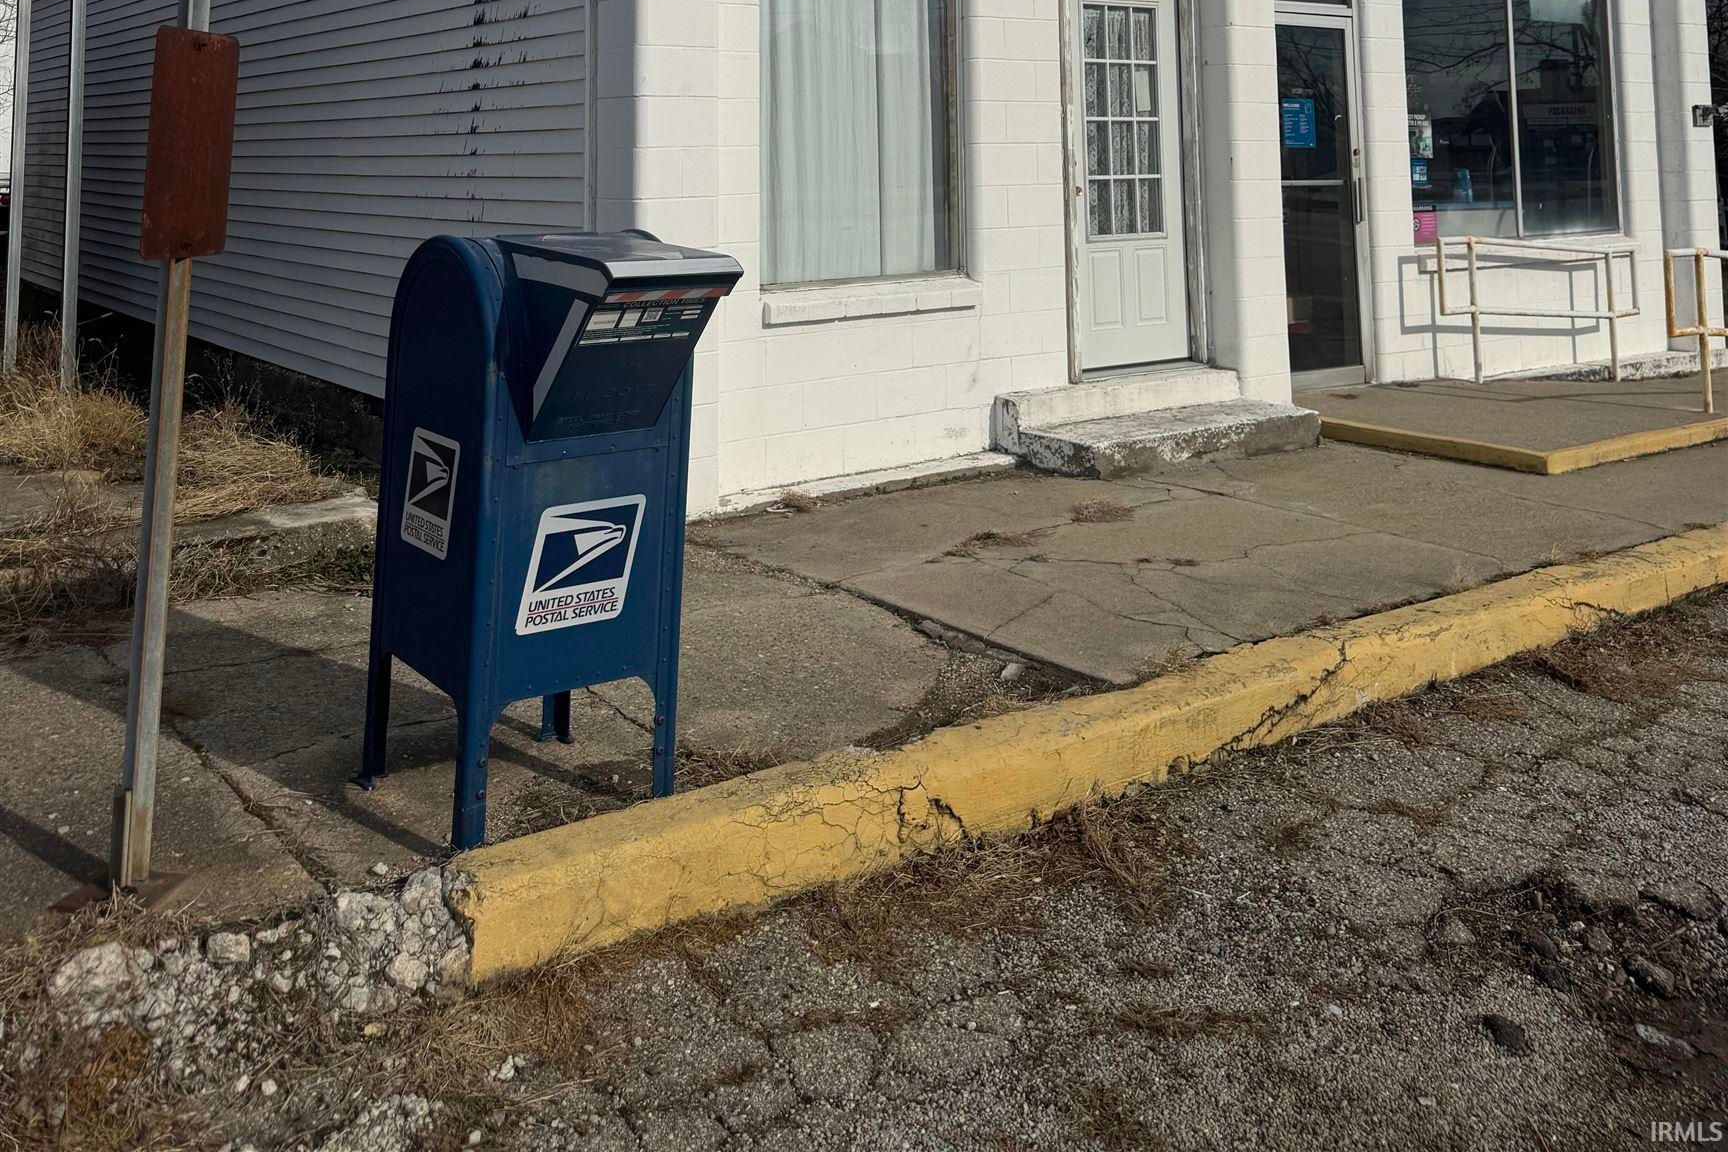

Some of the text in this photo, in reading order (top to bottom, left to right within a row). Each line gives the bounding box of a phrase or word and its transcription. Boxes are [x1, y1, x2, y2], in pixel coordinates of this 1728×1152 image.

[623, 299, 678, 308] COLLECTION
[405, 511, 444, 537] UNITED STATES
[403, 524, 445, 552] POSTAL SERVICE
[528, 587, 615, 612] UNITED STATES
[525, 600, 619, 628] POSTAL SERVICE
